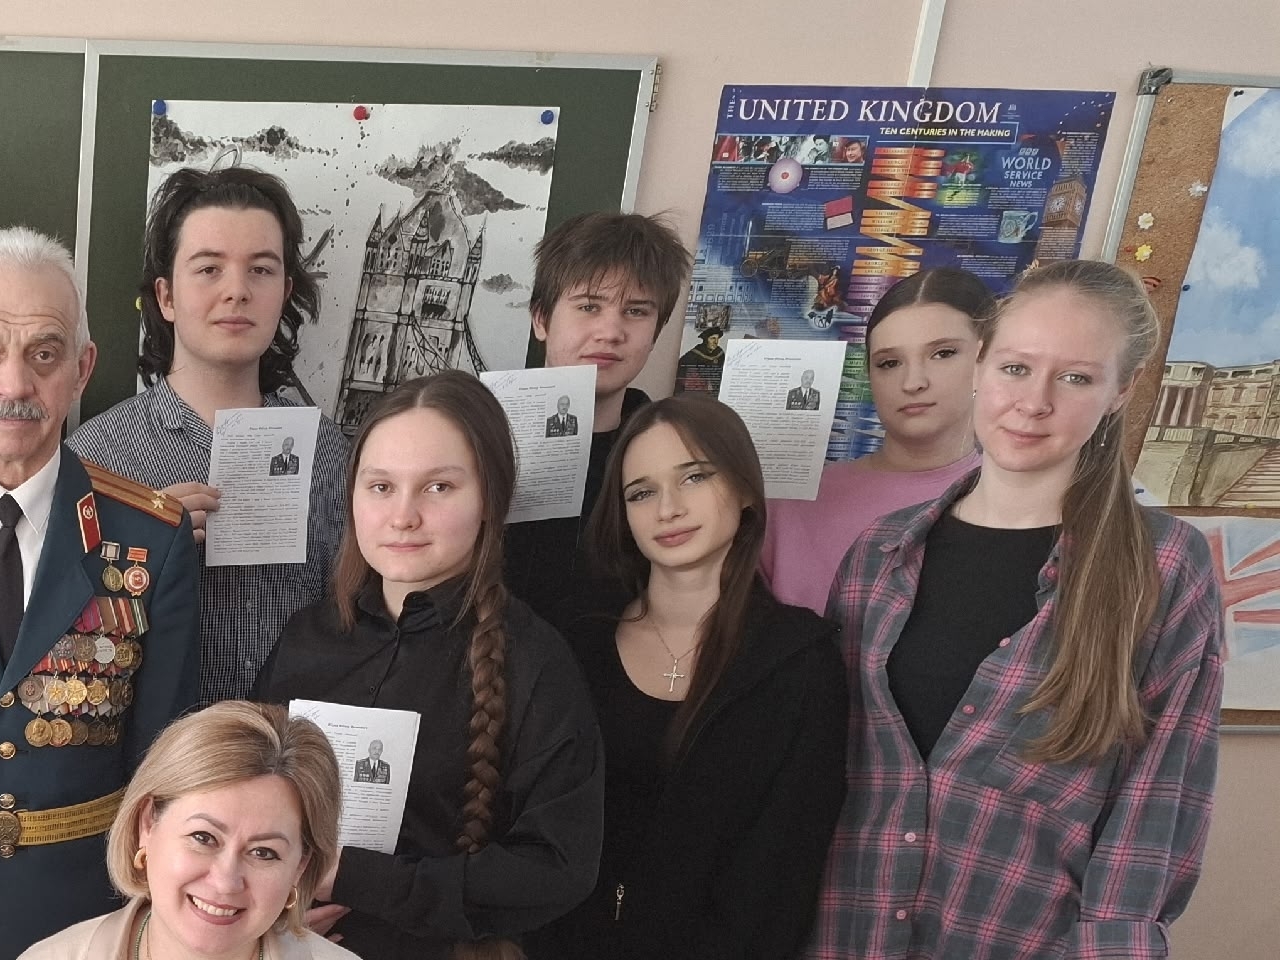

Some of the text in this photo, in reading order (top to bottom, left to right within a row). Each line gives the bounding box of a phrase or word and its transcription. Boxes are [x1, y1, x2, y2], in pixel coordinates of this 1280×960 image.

[739, 98, 849, 121] UNITED
[857, 99, 1002, 123] KINGDOM
[879, 127, 1011, 137] TEN CENTURIES IN THE MAKING
[1001, 157, 1051, 170] WORLD
[1004, 171, 1043, 179] SERVICE
[1010, 180, 1033, 188] NEWS
